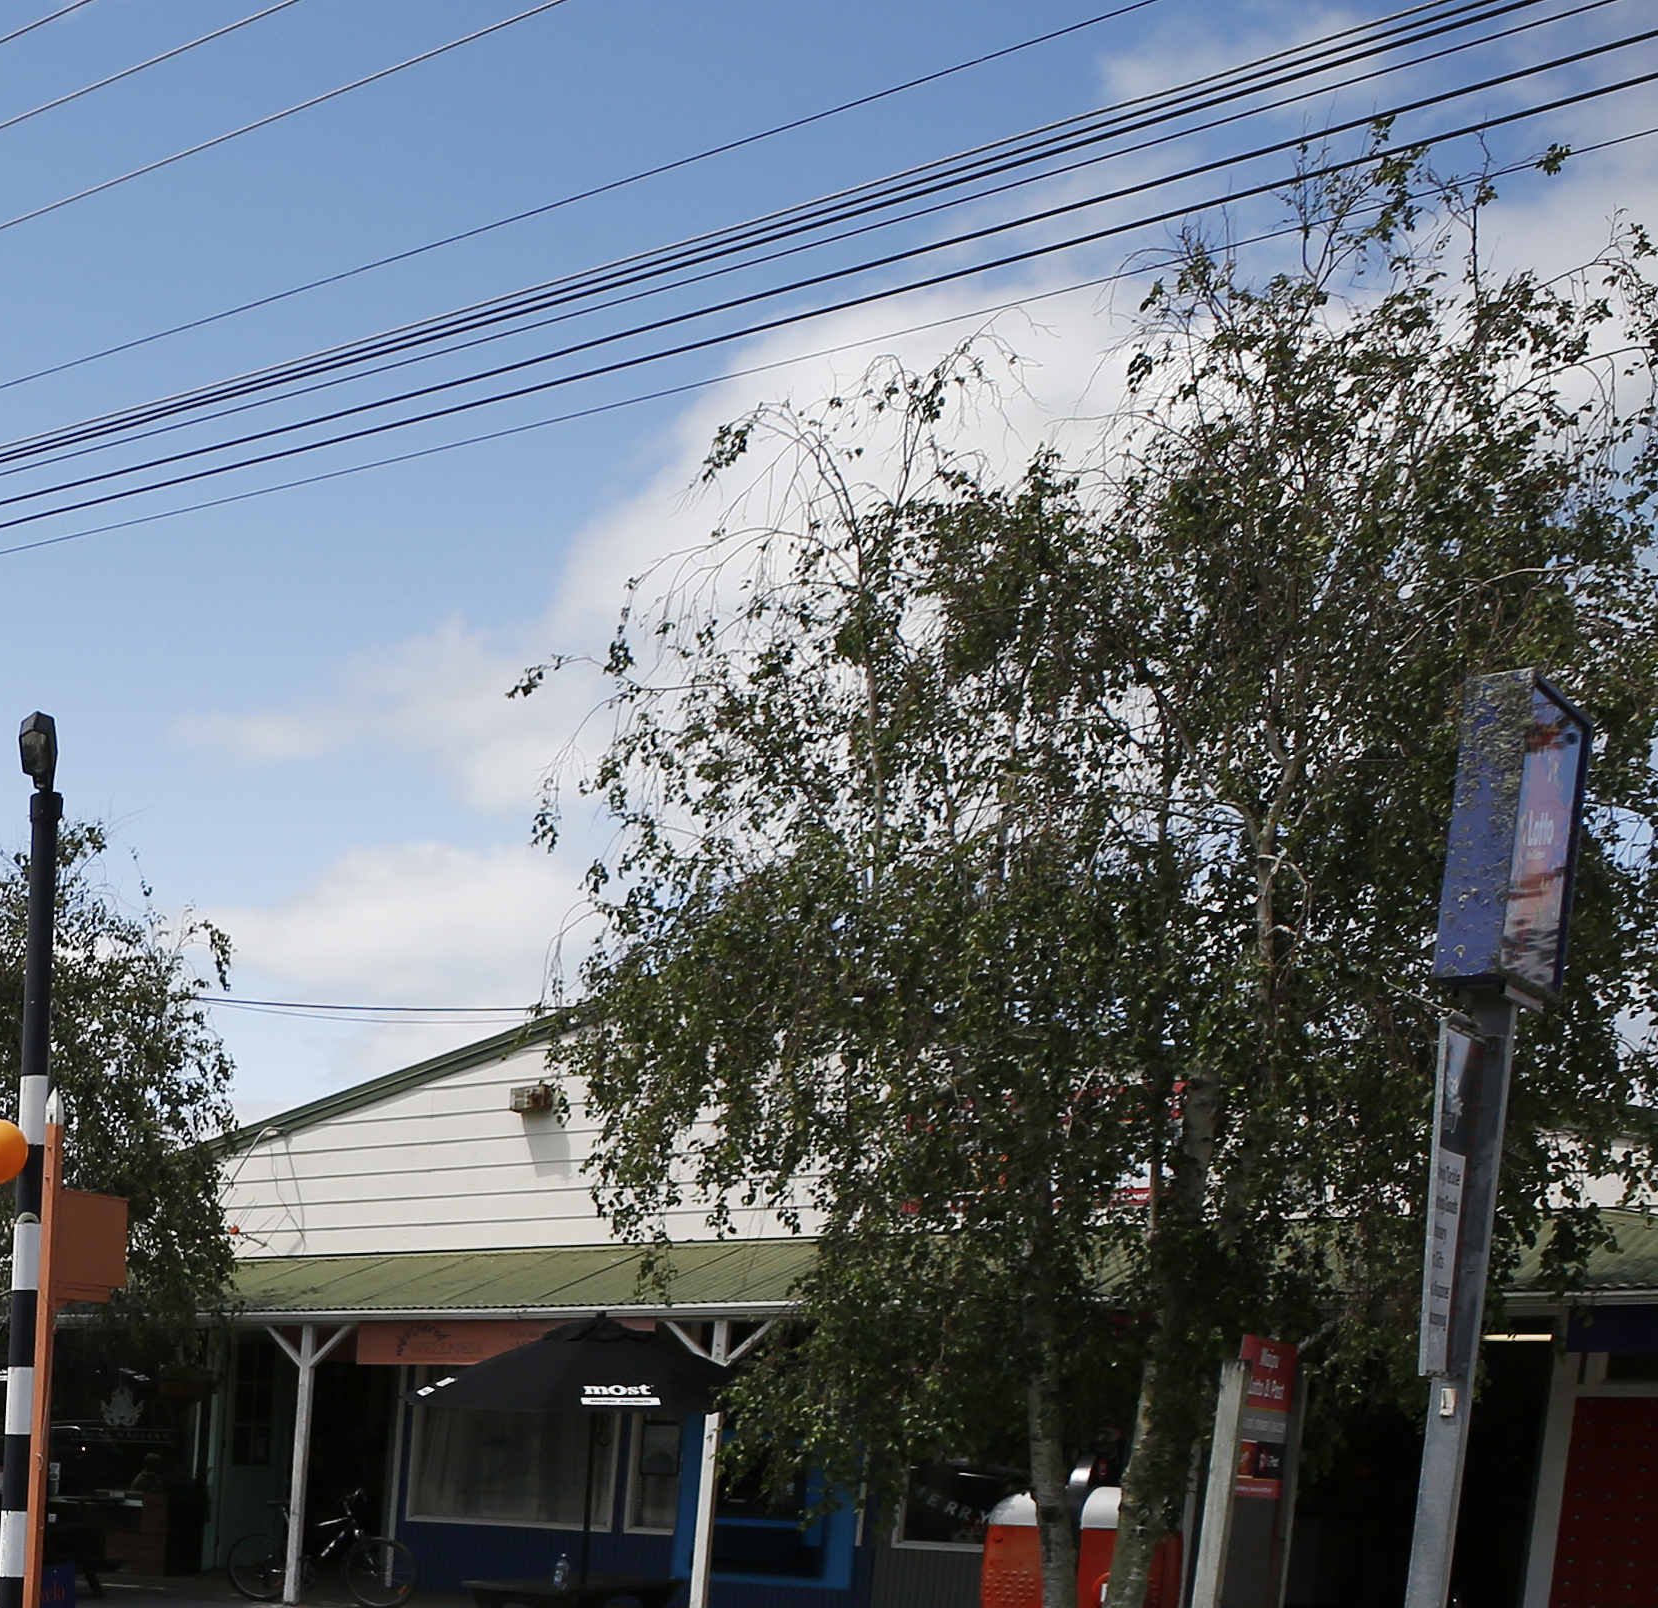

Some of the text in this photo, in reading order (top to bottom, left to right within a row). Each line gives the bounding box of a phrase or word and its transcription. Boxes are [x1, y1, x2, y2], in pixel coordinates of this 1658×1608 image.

[1527, 810, 1555, 847] Lotto
[411, 1342, 483, 1353] WELLNESS
[1260, 1347, 1280, 1373] Waipu
[1248, 1376, 1265, 1397] Lotto
[1271, 1380, 1285, 1400] Post
